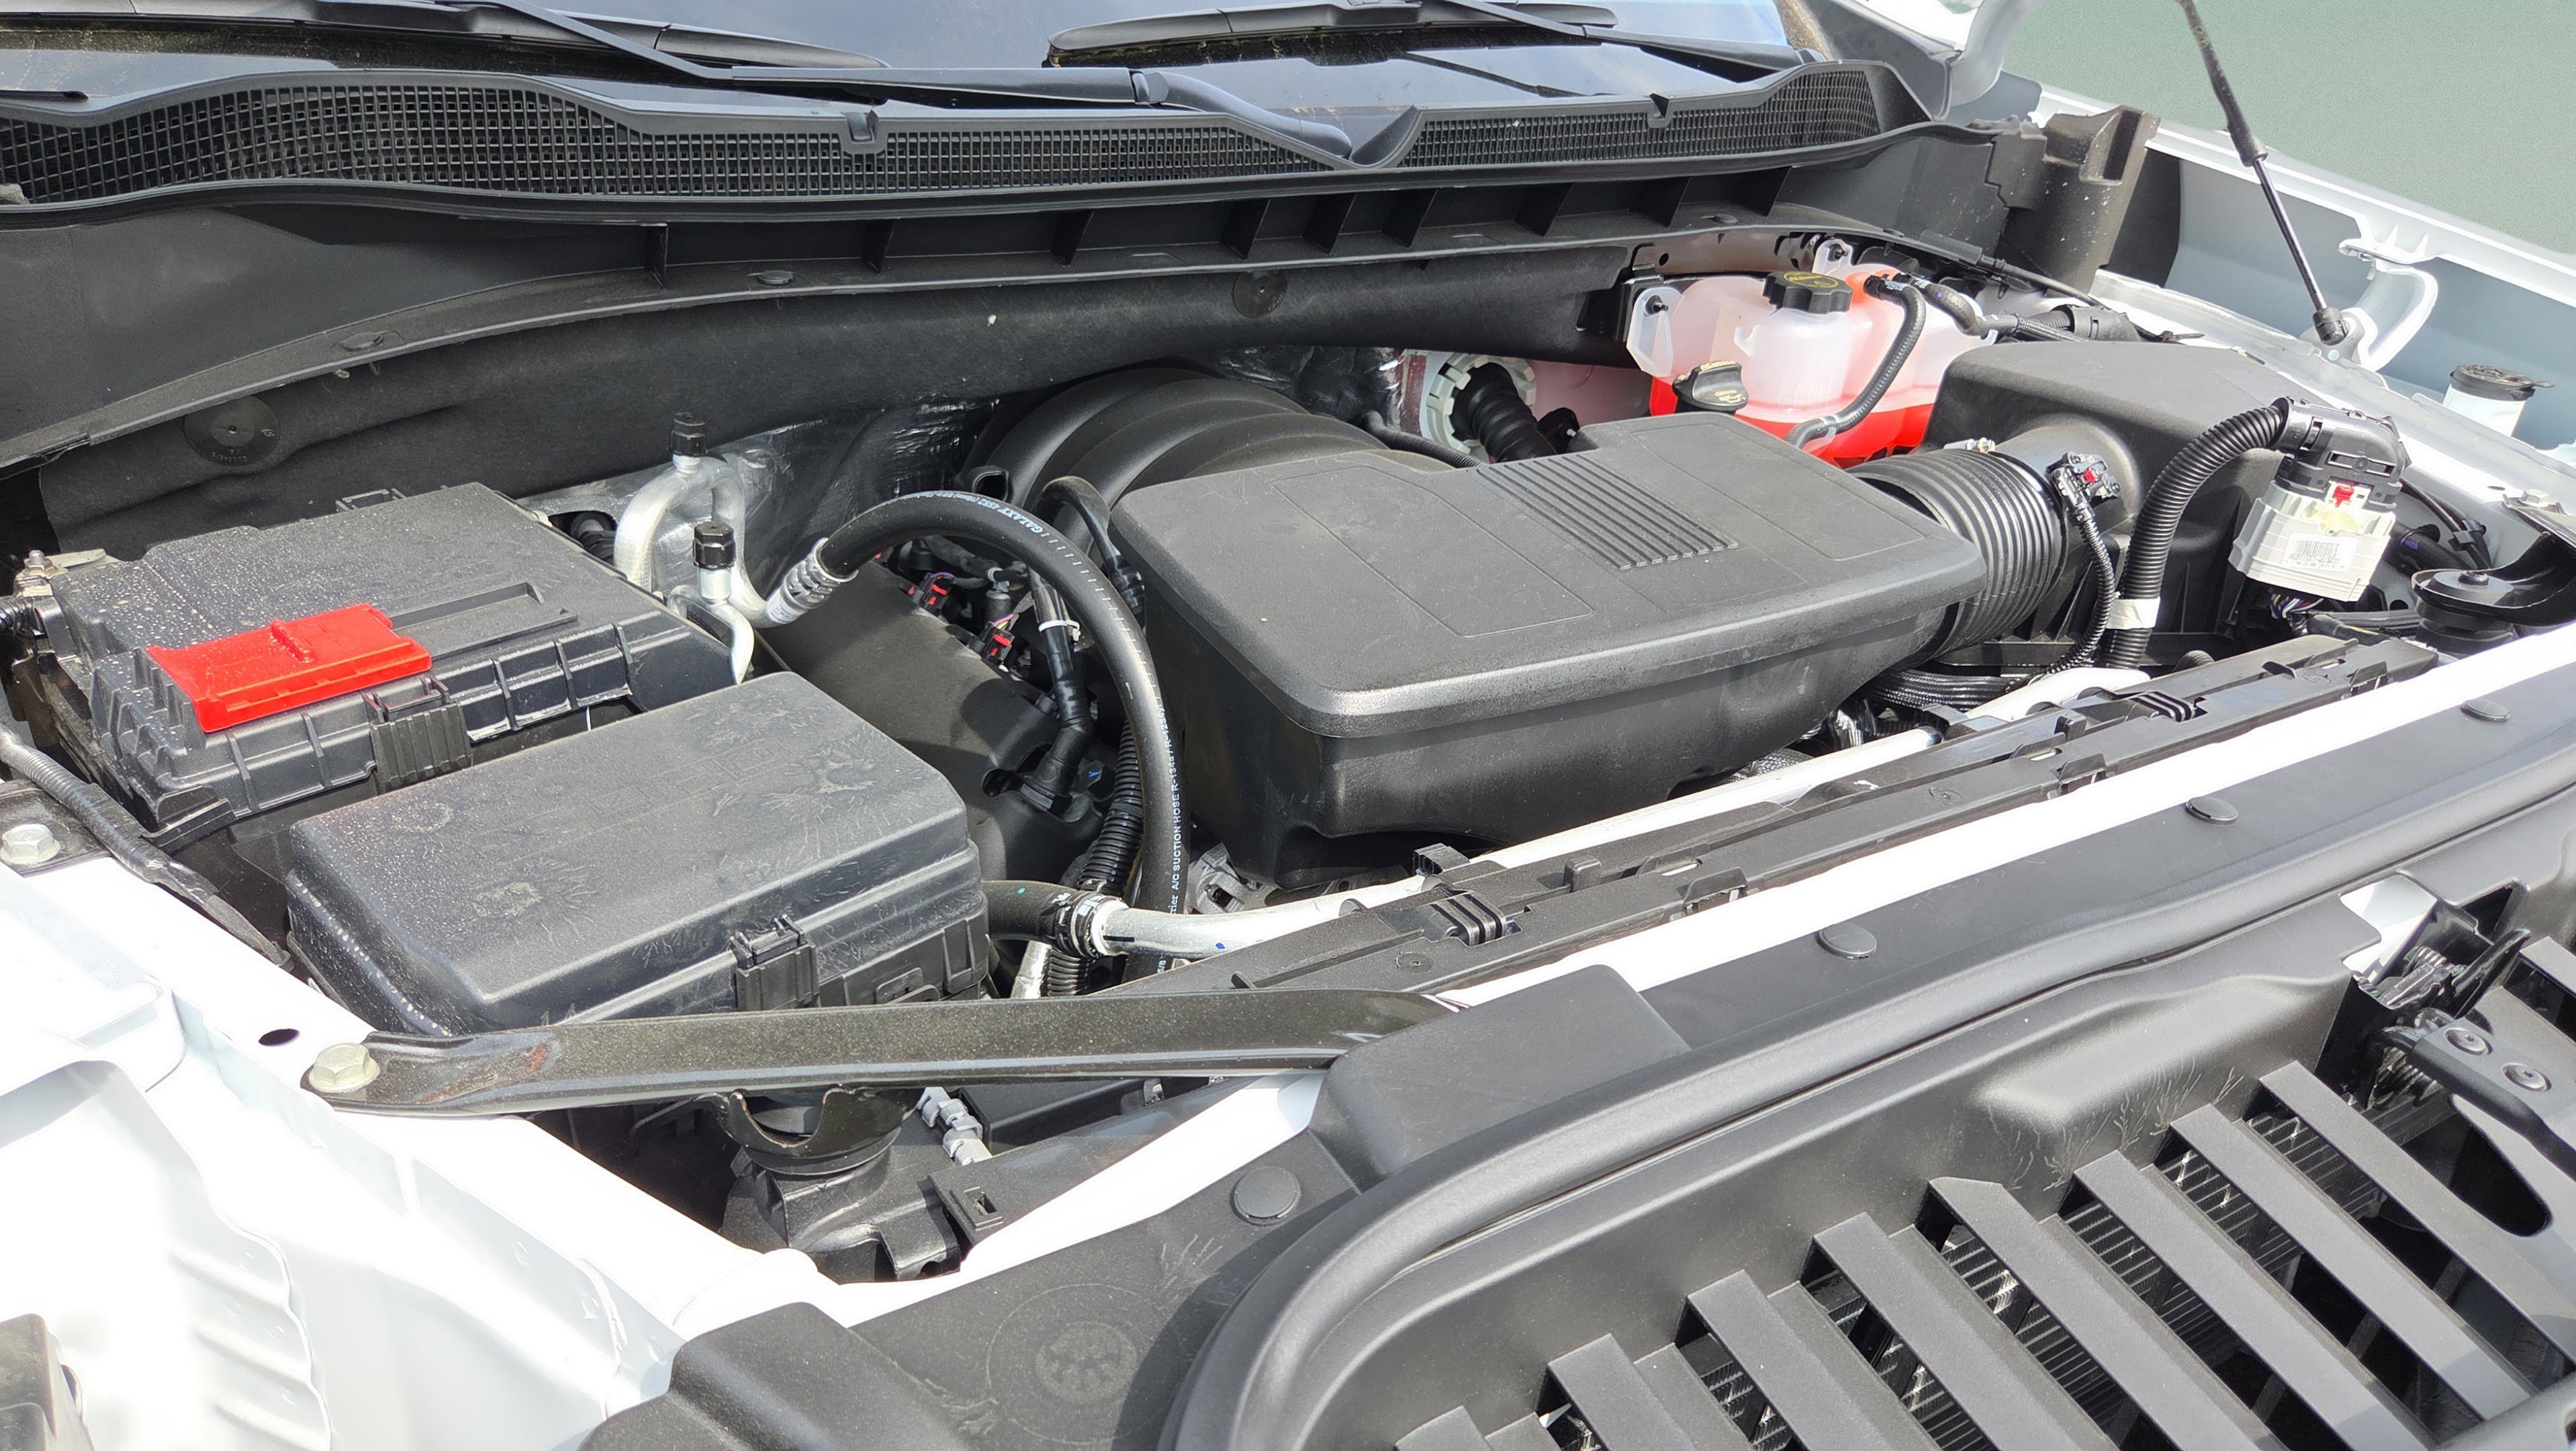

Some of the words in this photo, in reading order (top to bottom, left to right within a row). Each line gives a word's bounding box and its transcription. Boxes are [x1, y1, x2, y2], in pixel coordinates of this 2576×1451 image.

[997, 507, 1044, 533] GALAXY
[1168, 756, 1179, 792] R-134a
[1172, 794, 1181, 824] HOSE
[1173, 826, 1182, 871] SUCTION
[1171, 873, 1180, 890] A/C
